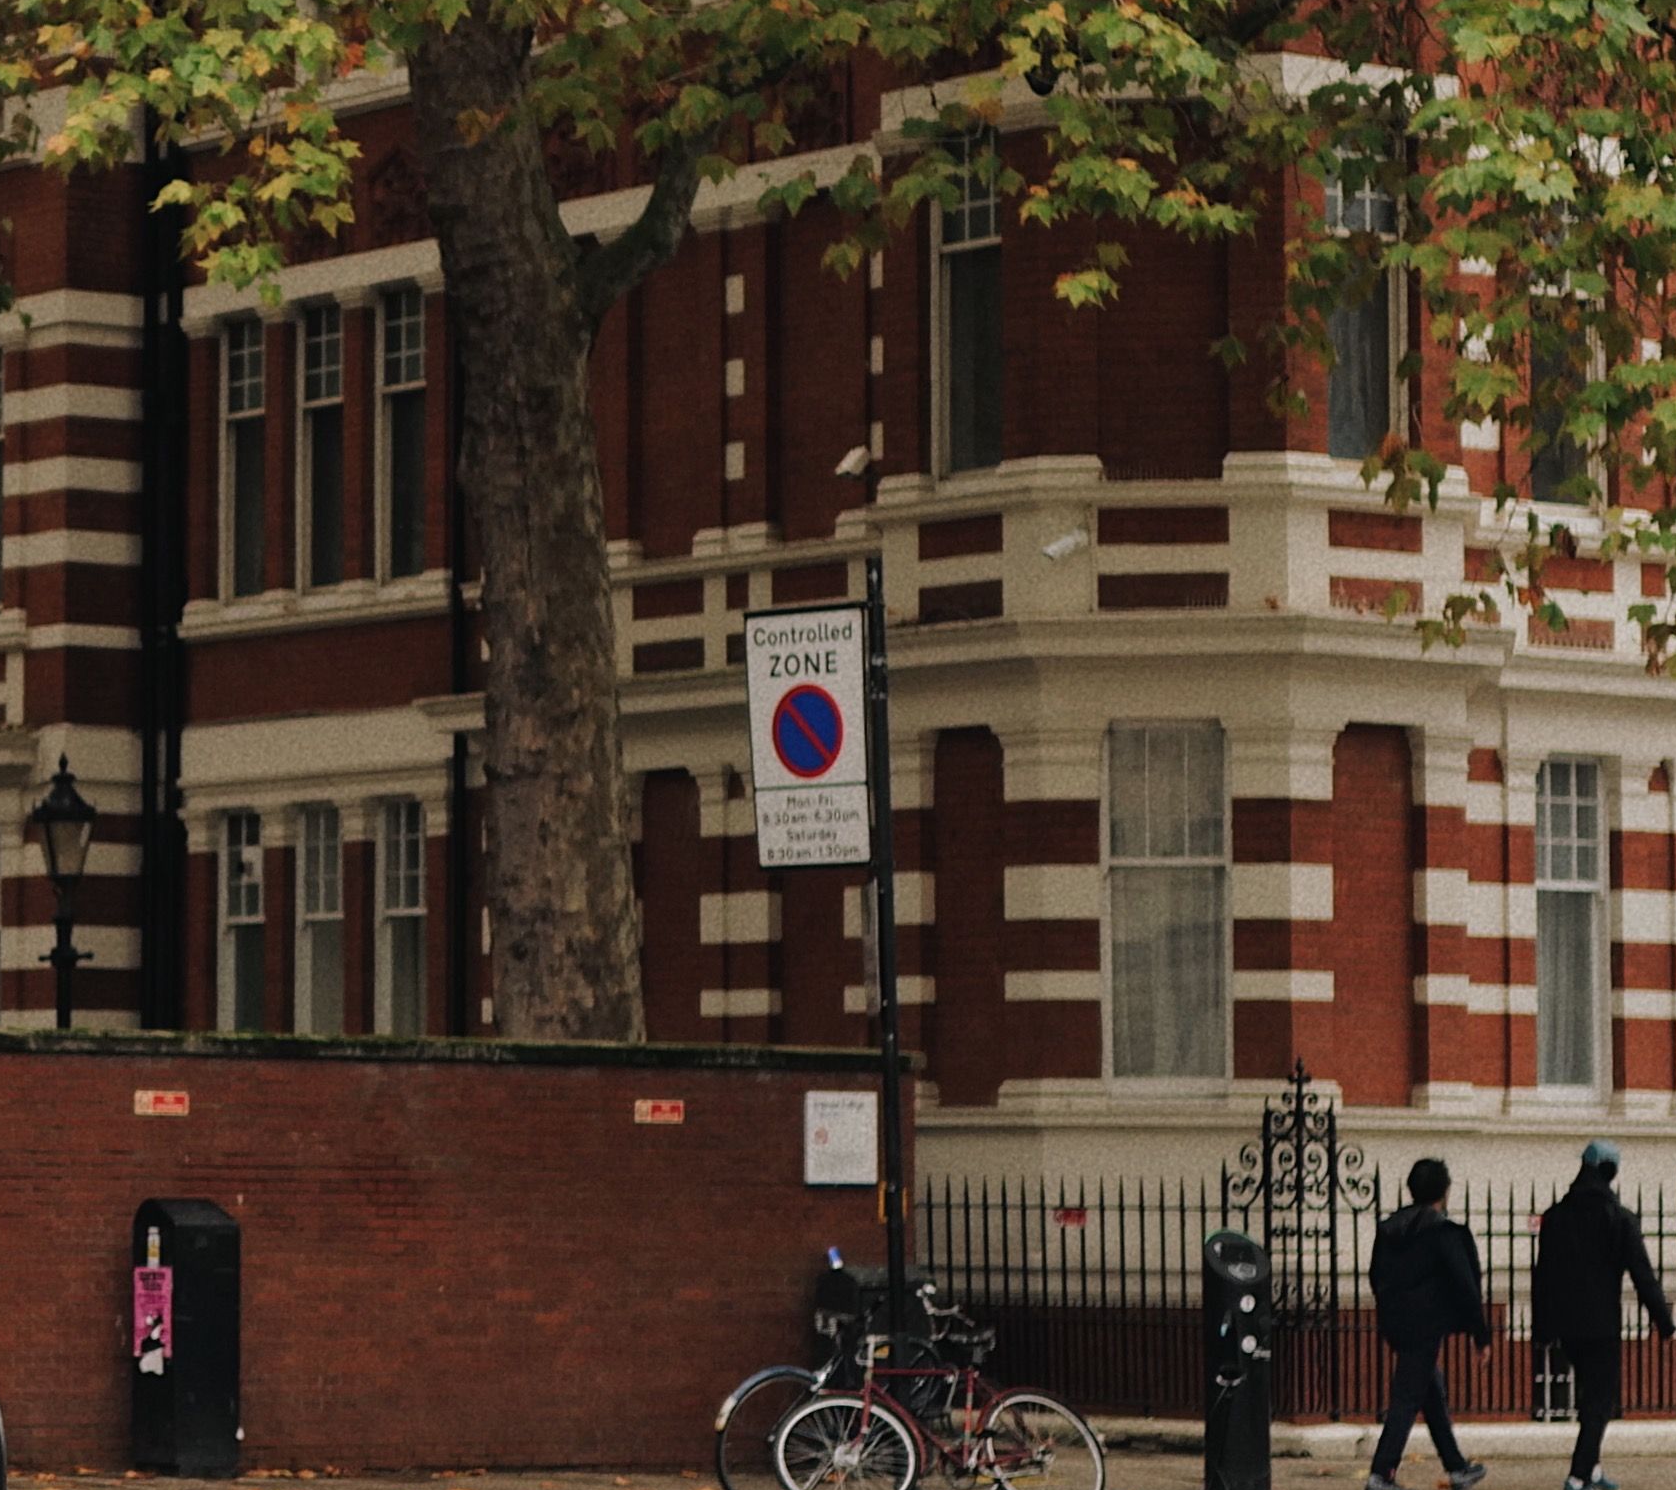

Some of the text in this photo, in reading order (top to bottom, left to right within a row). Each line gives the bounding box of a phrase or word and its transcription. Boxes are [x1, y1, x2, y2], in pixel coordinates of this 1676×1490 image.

[753, 621, 854, 647] Controlled
[769, 650, 839, 679] ZONE
[786, 796, 811, 809] Mon
[786, 829, 838, 843] Saturday
